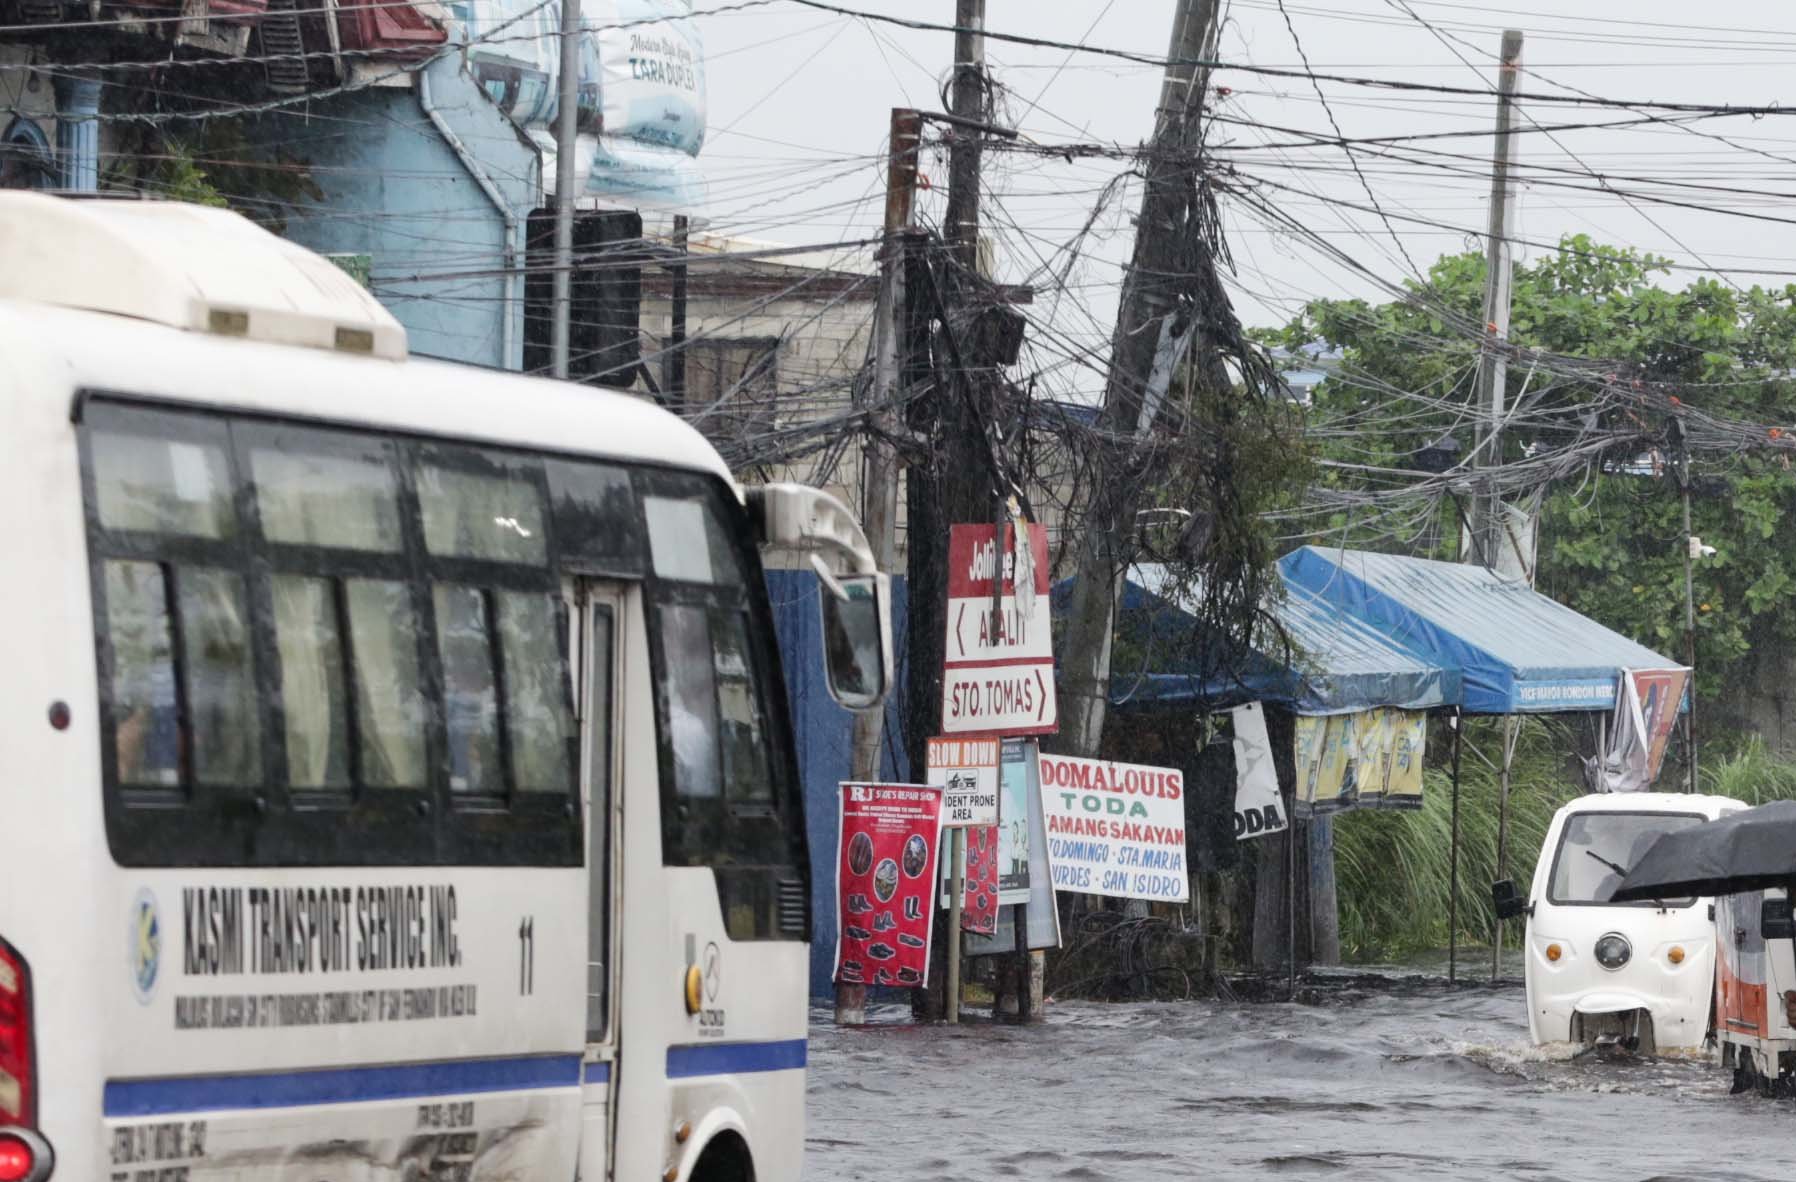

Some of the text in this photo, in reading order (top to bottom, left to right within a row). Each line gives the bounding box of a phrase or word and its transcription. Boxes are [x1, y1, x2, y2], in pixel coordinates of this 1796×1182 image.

[969, 537, 1013, 582] Jollie
[951, 677, 1033, 718] STO. TOMAS
[928, 741, 997, 767] SLOW DOWN
[850, 786, 874, 802] RJ
[897, 790, 920, 801] REPAIR
[1040, 759, 1181, 800] DOMALOUIS
[944, 794, 995, 808] IDENT PRONE
[952, 808, 973, 821] AREA
[1060, 792, 1149, 818] TODA
[1046, 814, 1185, 846] AMANG SAKAYAN
[1048, 838, 1109, 863] TO.DOMINGO
[1051, 863, 1182, 898] URDES SAN ISIDRO
[183, 884, 463, 976] KASMI TRANSPORT SERVICE INC.
[518, 915, 534, 997] 11
